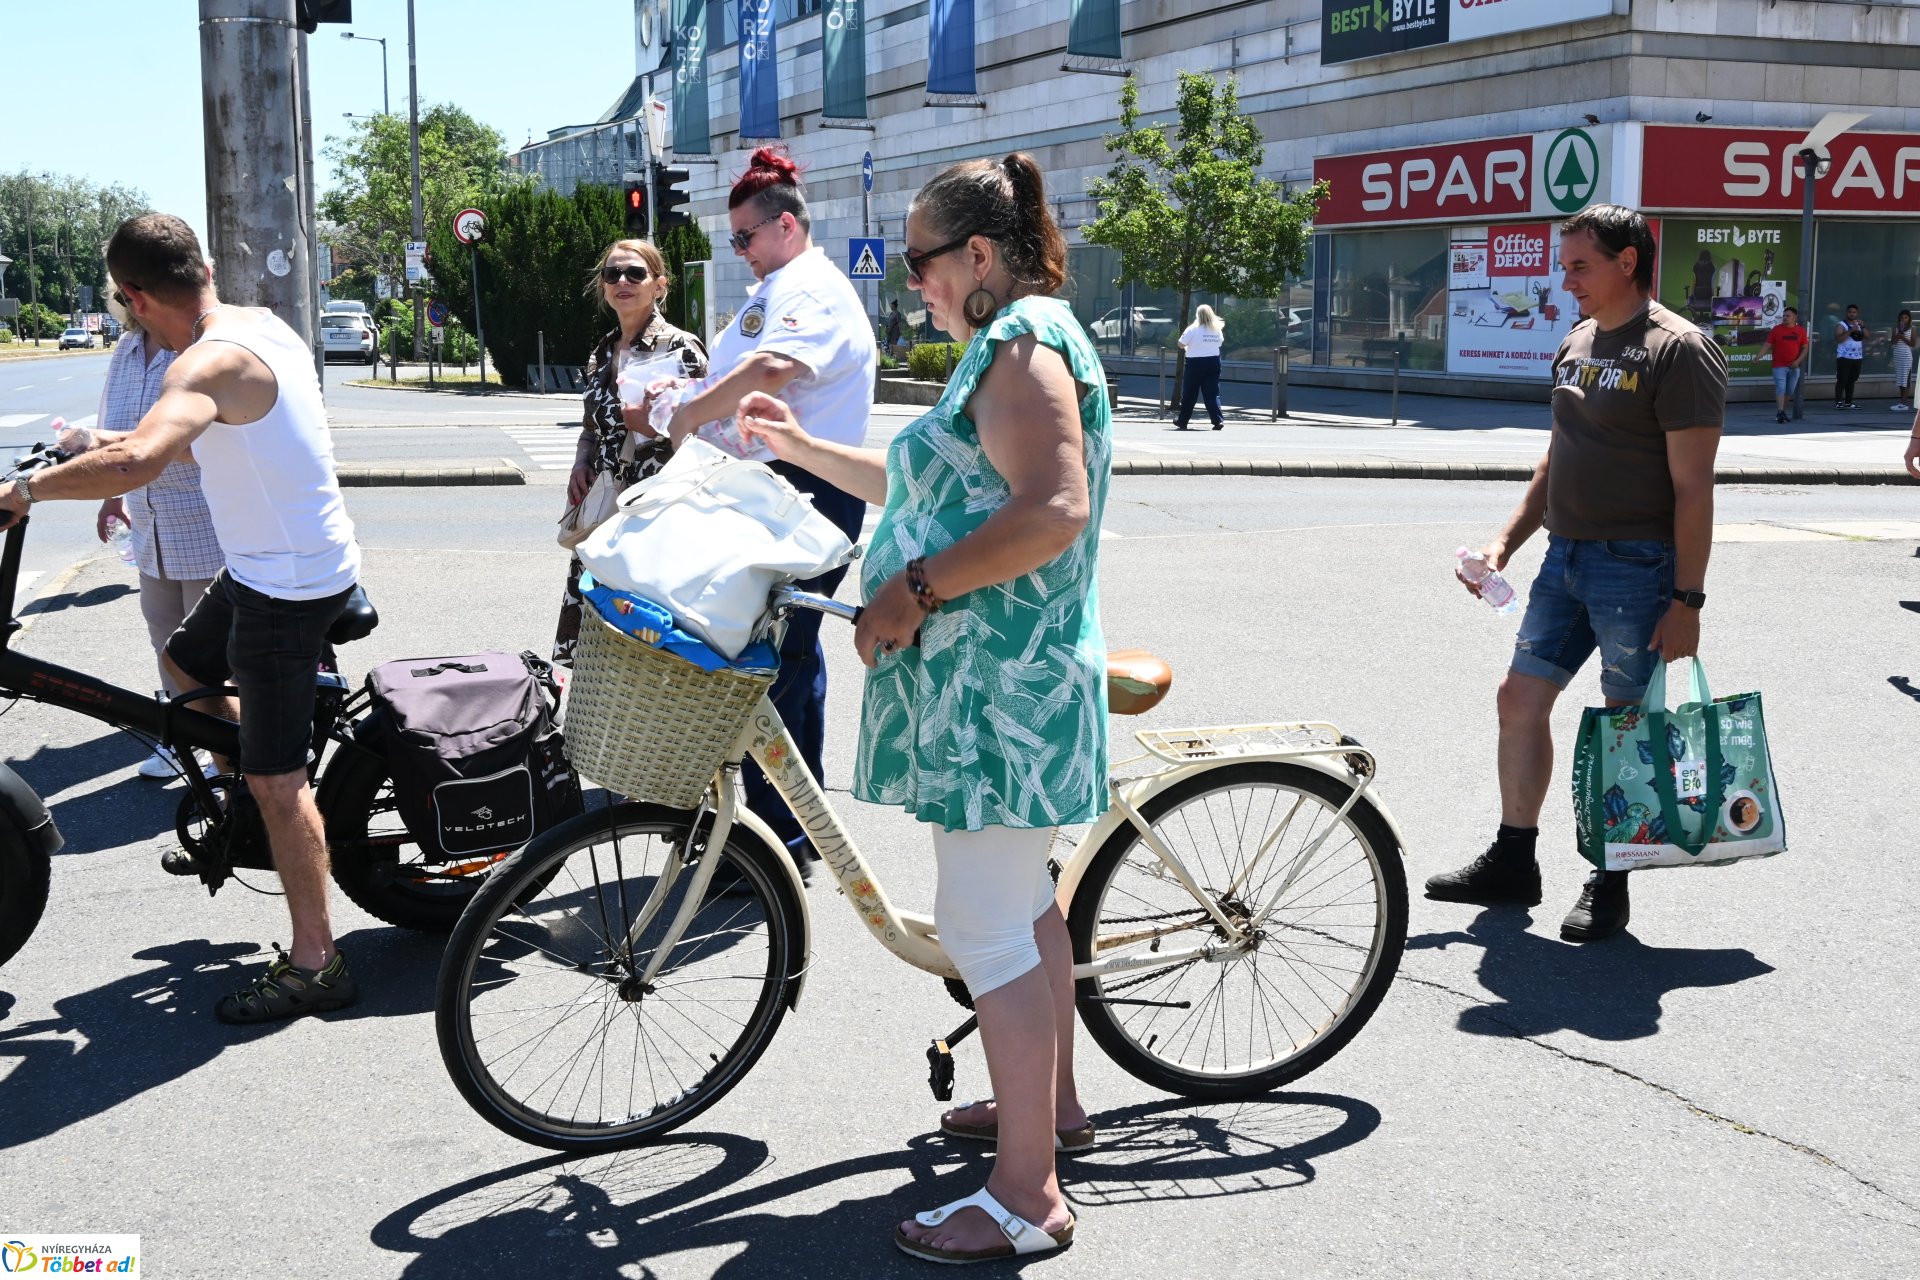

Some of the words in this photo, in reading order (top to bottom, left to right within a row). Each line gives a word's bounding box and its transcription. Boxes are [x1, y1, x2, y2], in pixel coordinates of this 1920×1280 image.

[1331, 6, 1370, 35] BEST
[1392, 0, 1436, 22] BYTE
[1392, 18, 1436, 33] www.bestbyte.hu
[1362, 148, 1526, 212] SPAR
[1493, 233, 1544, 254] Office
[1697, 229, 1731, 243] BEST
[1747, 229, 1781, 244] BYTE
[1494, 253, 1543, 268] DEPOT
[1459, 349, 1481, 358] KERESS
[1481, 349, 1504, 359] MINKET
[1505, 350, 1510, 359] A
[1510, 349, 1532, 359] KORZÓ
[1730, 352, 1751, 361] KORZÓ
[1720, 719, 1733, 730] so
[1735, 716, 1753, 730] wie
[1731, 735, 1756, 748] mag.
[444, 814, 526, 832] VELOTECH
